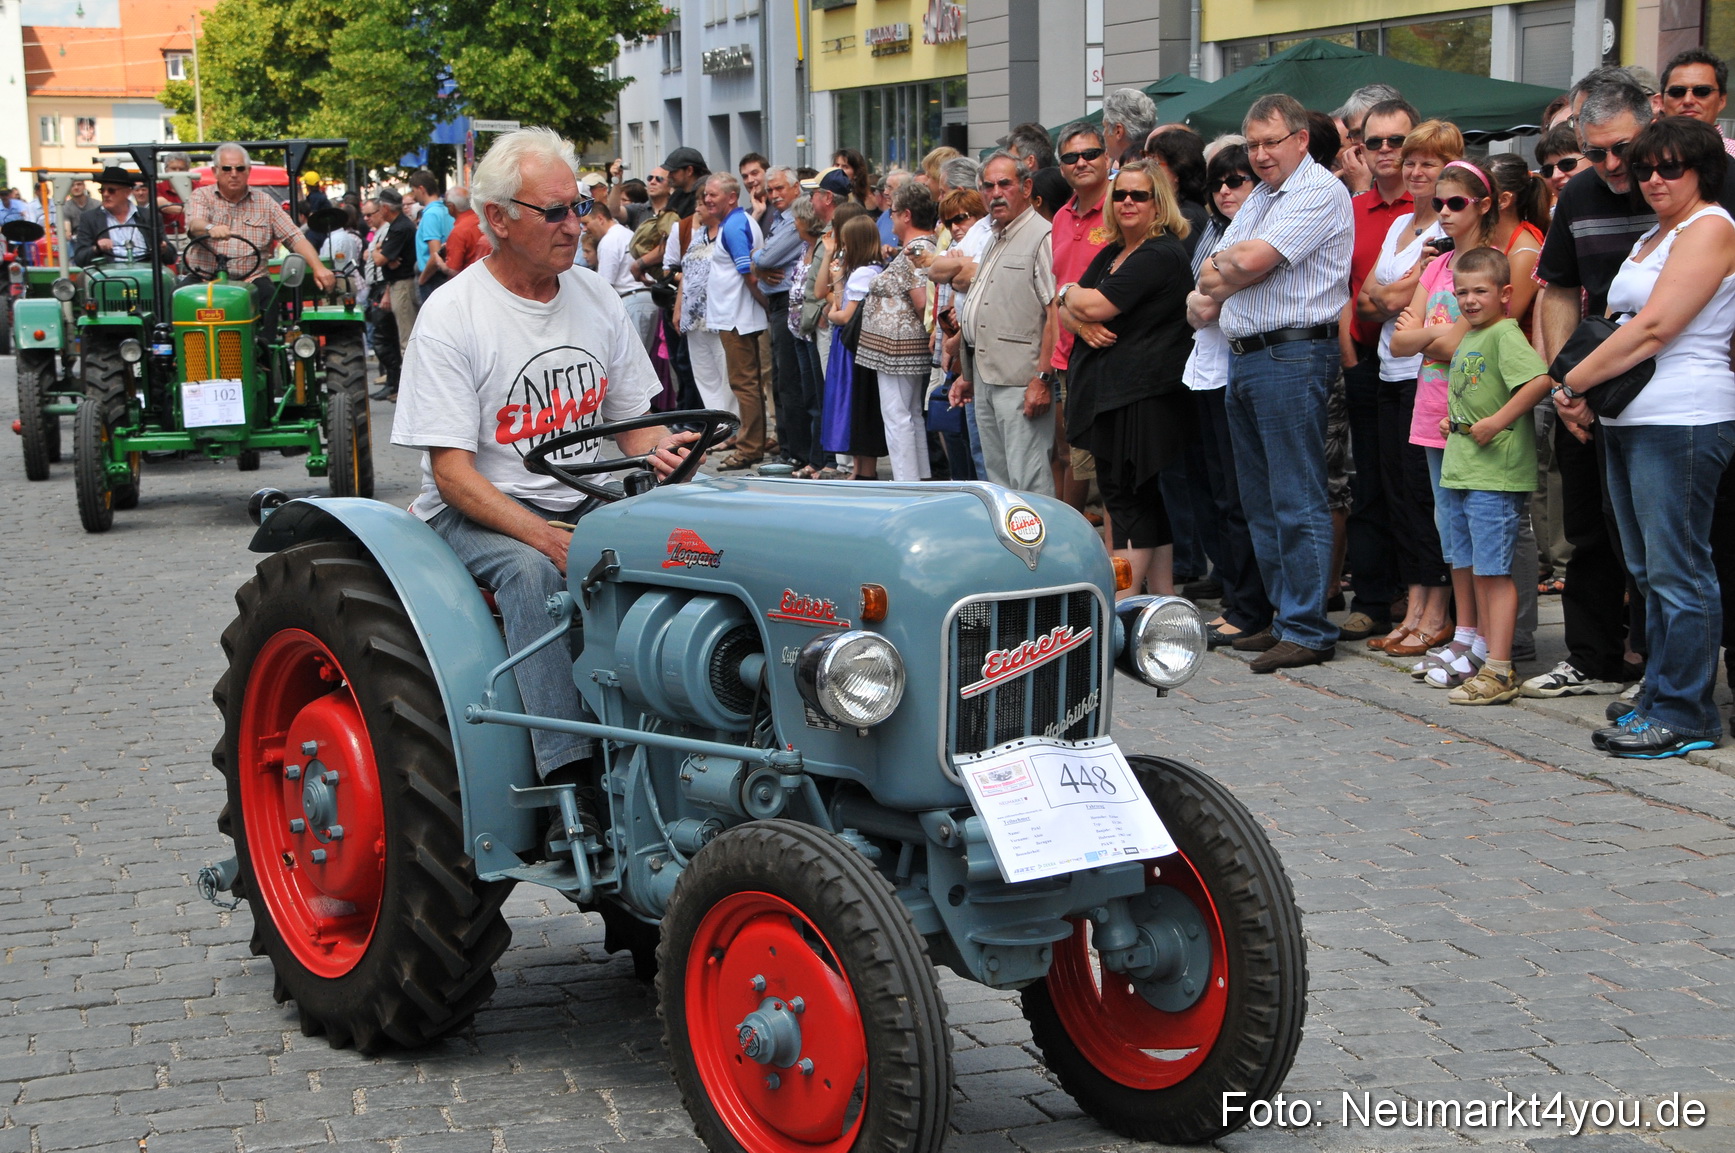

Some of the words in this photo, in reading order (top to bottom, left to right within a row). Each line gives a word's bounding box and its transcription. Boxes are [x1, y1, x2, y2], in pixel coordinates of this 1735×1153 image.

[213, 388, 237, 401] 102
[495, 377, 609, 445] Eicher
[1010, 516, 1041, 532] Eicher
[671, 543, 725, 569] Leopard
[779, 588, 838, 620] Eicher
[981, 625, 1074, 679] Eicher
[1059, 763, 1117, 796] 448
